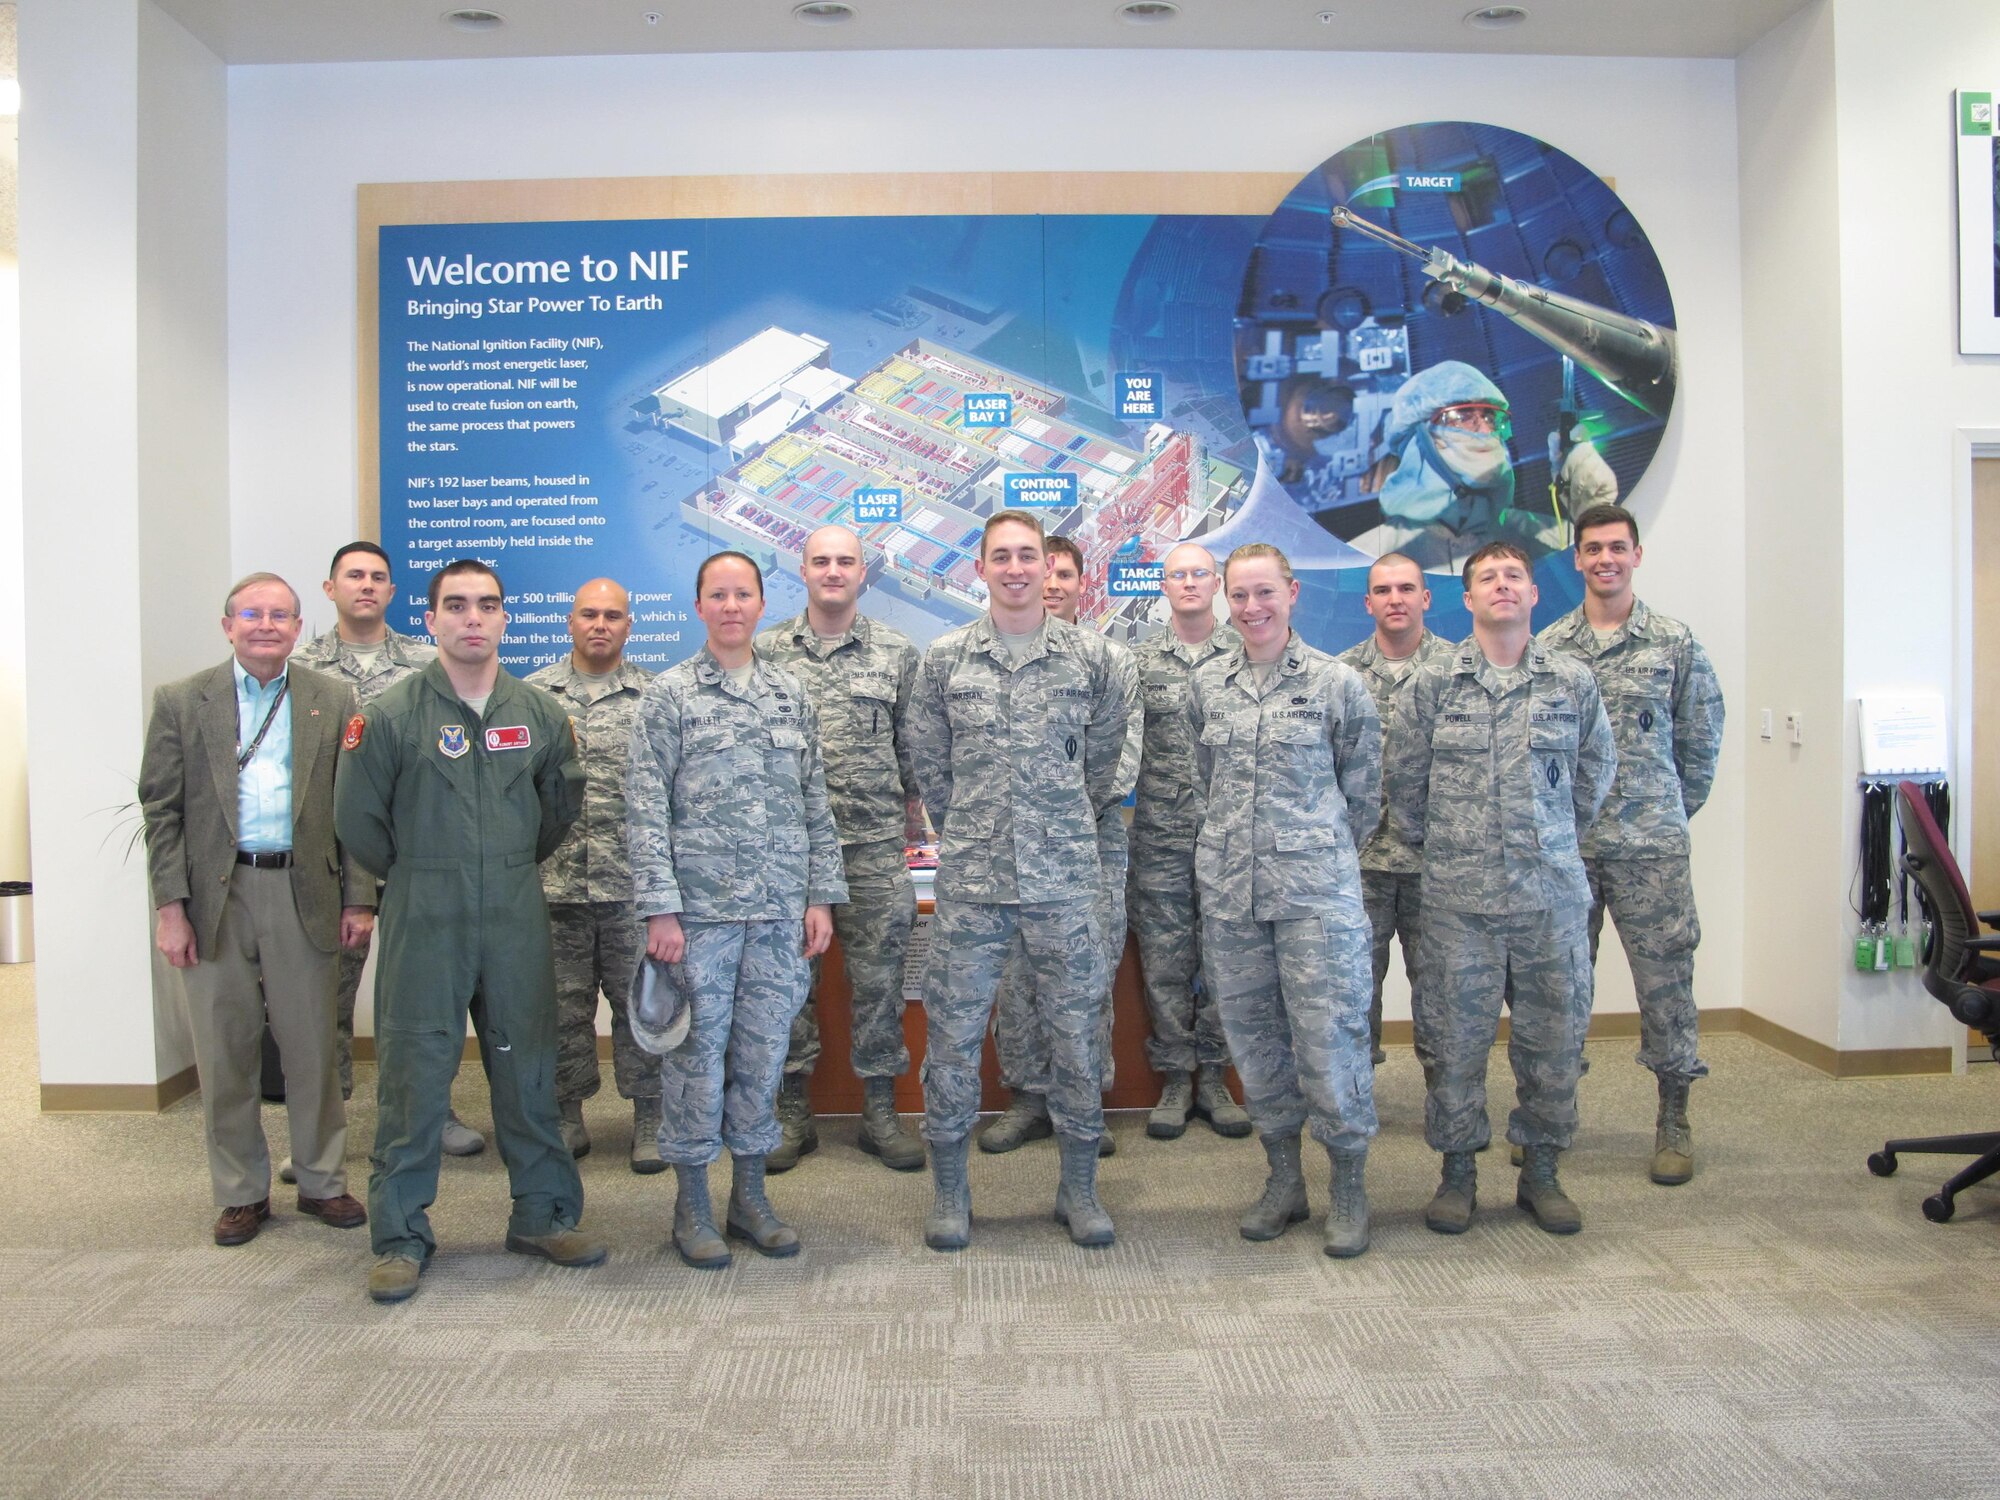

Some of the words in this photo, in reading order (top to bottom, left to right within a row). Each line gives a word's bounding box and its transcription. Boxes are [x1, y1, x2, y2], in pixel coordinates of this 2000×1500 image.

[1406, 177, 1454, 188] TARGET
[407, 254, 571, 286] Welcome
[581, 255, 618, 283] to
[630, 251, 689, 281] NIF
[408, 299, 483, 320] Bringing
[489, 298, 524, 313] Star
[529, 297, 585, 313] Power
[589, 296, 611, 312] To
[617, 294, 663, 312] Earth
[406, 341, 429, 351] The
[432, 340, 479, 351] National
[483, 339, 527, 353] Ignition
[530, 338, 569, 351] Facility
[571, 337, 603, 350] (NIF),
[407, 361, 426, 372] the
[428, 360, 469, 371] world's
[472, 360, 501, 370] most
[503, 358, 557, 372] energetic
[560, 358, 588, 369] laser,
[407, 381, 416, 392] is
[418, 383, 444, 391] now
[446, 379, 514, 394] operational.
[518, 379, 537, 389] NIF
[540, 378, 559, 388] will
[562, 378, 577, 388] be
[1125, 378, 1152, 389] YOU
[1126, 390, 1152, 401] ARE
[407, 401, 434, 412] used
[435, 402, 449, 411] to
[452, 401, 487, 410] create
[489, 399, 524, 410] fusion
[527, 401, 542, 409] on
[544, 398, 578, 410] earth,
[968, 399, 1007, 410] LASER
[1123, 402, 1155, 414] HERE
[969, 411, 995, 422] BAY
[998, 411, 1005, 422] 1
[407, 421, 426, 432] the
[429, 423, 459, 431] same
[461, 422, 504, 433] process
[507, 419, 531, 429] that
[533, 421, 575, 432] powers
[407, 441, 427, 452] the
[429, 442, 458, 451] stars.
[408, 478, 435, 488] NIF's
[438, 477, 459, 487] 192
[461, 477, 488, 487] laser
[490, 476, 531, 488] beams,
[534, 474, 576, 486] housed
[579, 475, 589, 485] in
[1010, 478, 1071, 489] CONTROL
[858, 494, 898, 505] LASER
[1020, 490, 1062, 502] ROOM
[408, 499, 430, 508] two
[432, 497, 460, 508] laser
[461, 497, 488, 510] bays
[490, 496, 512, 507] and
[515, 495, 567, 509] operated
[570, 495, 598, 505] from
[860, 507, 885, 518] BAY
[888, 507, 898, 518] 2
[408, 518, 427, 528] the
[430, 517, 470, 528] control
[473, 519, 507, 528] room,
[531, 515, 575, 526] focused
[578, 516, 606, 525] onto
[408, 541, 415, 549] a
[418, 538, 453, 551] target
[456, 536, 507, 550] assembly
[510, 536, 535, 546] held
[538, 535, 571, 546] inside
[574, 535, 593, 545] the
[408, 559, 443, 571] target
[1119, 567, 1165, 579] TARGET
[1112, 580, 1161, 592] CHAMB
[522, 593, 544, 604] 500
[546, 591, 576, 603] trillio
[635, 593, 673, 605] power
[409, 616, 422, 626] to
[515, 612, 568, 624] billionths
[641, 611, 676, 622] which
[679, 611, 688, 622] is
[501, 633, 527, 644] than
[530, 633, 549, 644] the
[552, 633, 574, 644] tota
[533, 653, 556, 667] grid
[626, 652, 670, 663] instant.
[1287, 711, 1299, 719] AIR
[1299, 711, 1323, 720] FORCE
[1445, 713, 1471, 723] POWELL
[1546, 713, 1558, 722] AIR
[1559, 713, 1577, 723] FORCE
